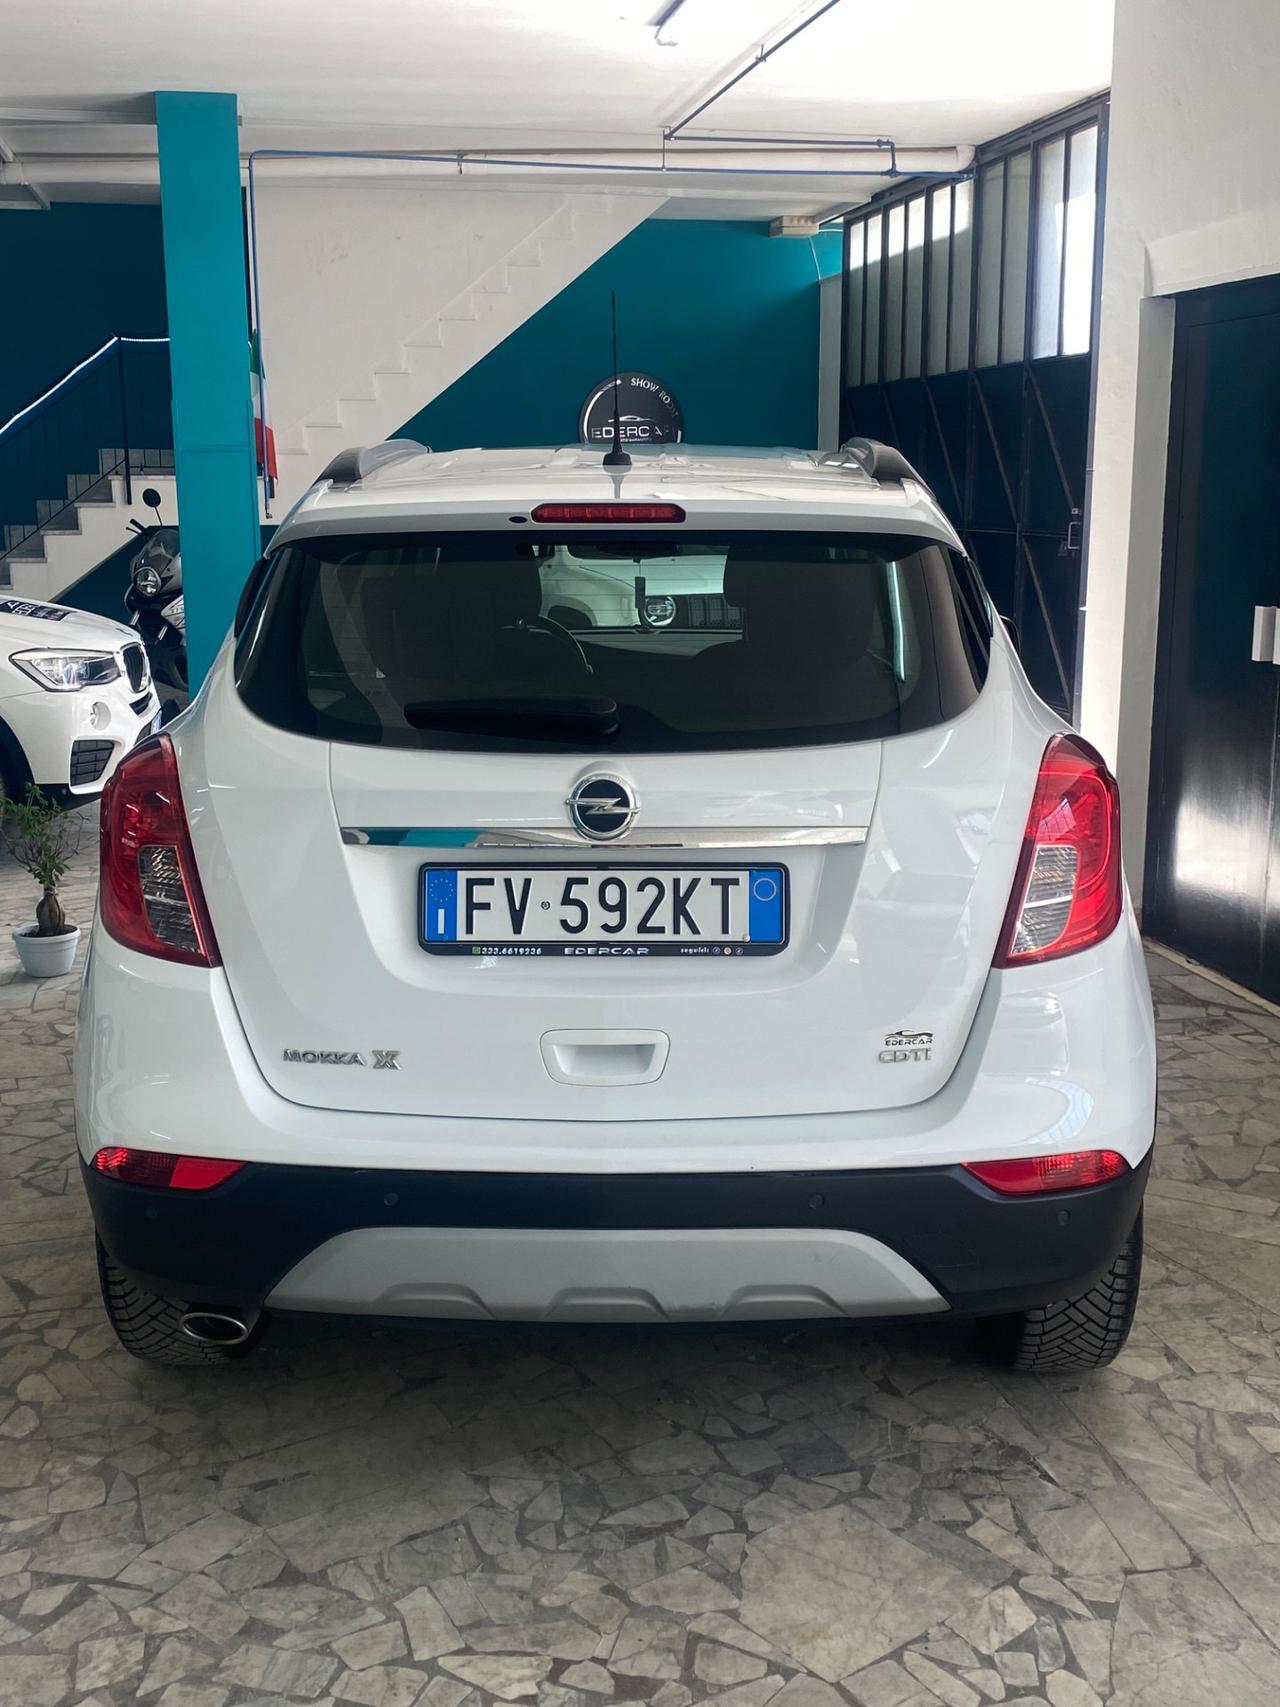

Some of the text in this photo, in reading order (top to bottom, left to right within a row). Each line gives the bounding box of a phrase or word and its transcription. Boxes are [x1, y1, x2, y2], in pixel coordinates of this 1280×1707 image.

[631, 377, 660, 393] SHOW
[466, 877, 740, 935] FV 592KT
[564, 947, 649, 955] EDERCAR
[884, 1038, 933, 1047] EDERCAR
[283, 1049, 401, 1070] MOKKA X
